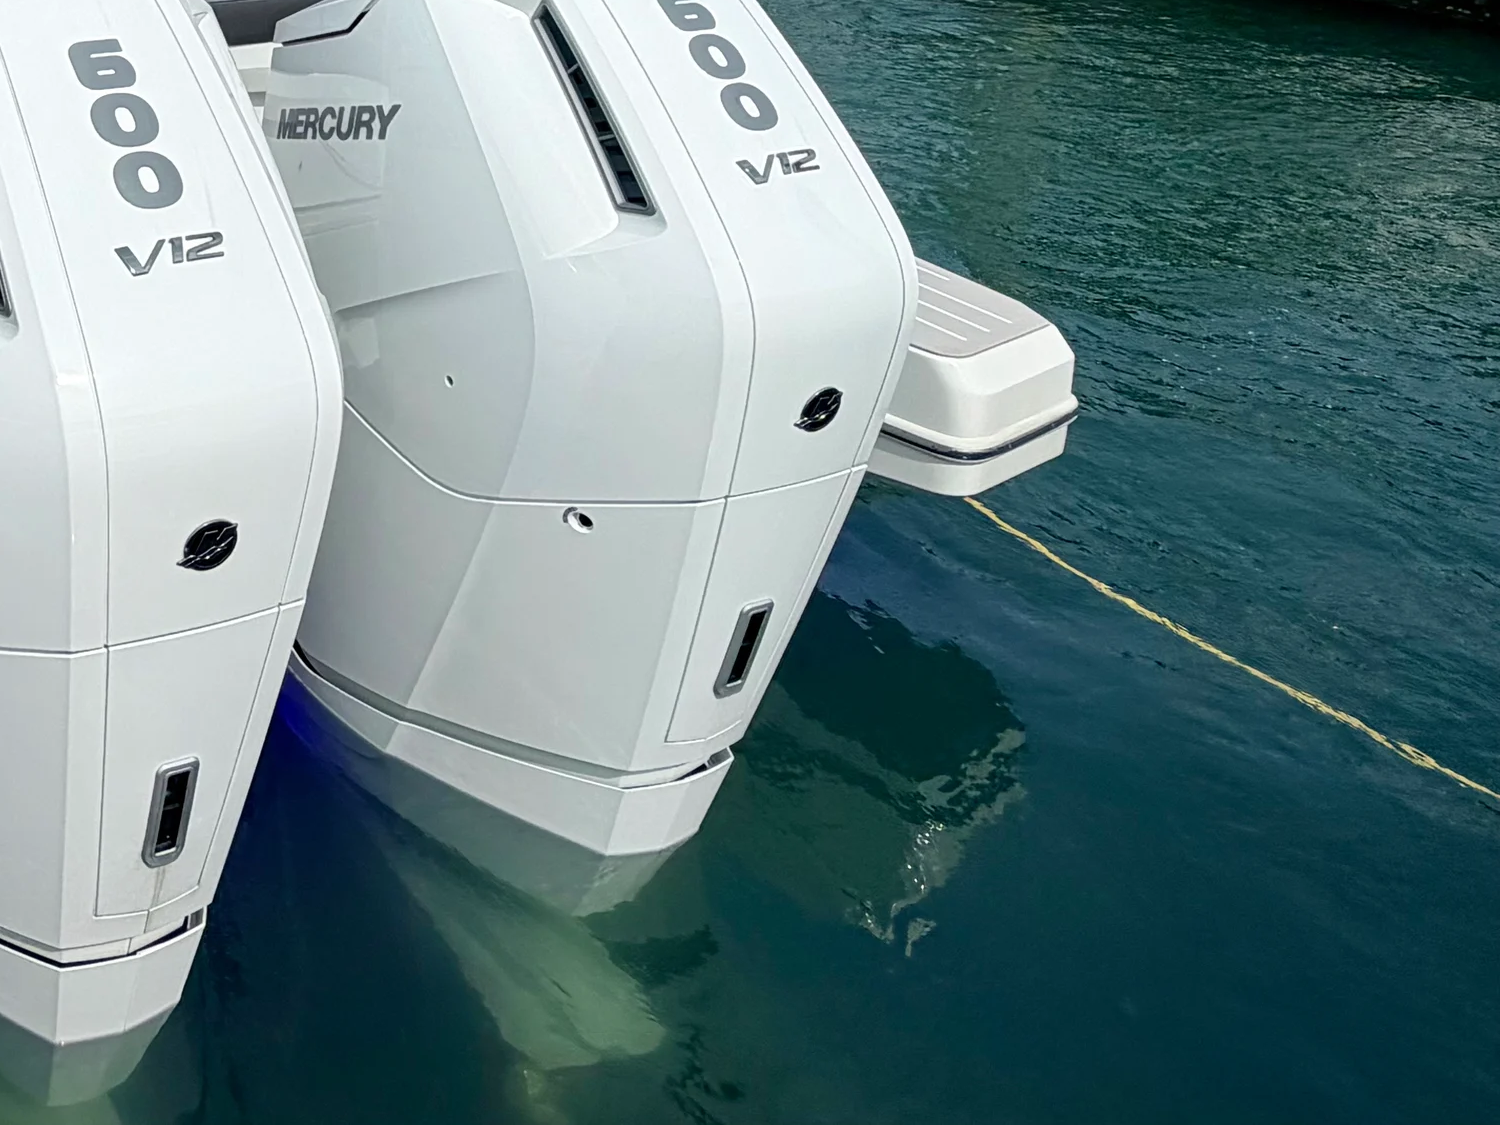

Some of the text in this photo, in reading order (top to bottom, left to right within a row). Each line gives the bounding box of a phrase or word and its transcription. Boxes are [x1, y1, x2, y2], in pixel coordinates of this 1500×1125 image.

[68, 38, 184, 210] 600
[276, 104, 402, 141] MERCURY
[735, 148, 820, 185] V12
[114, 231, 225, 277] V12
